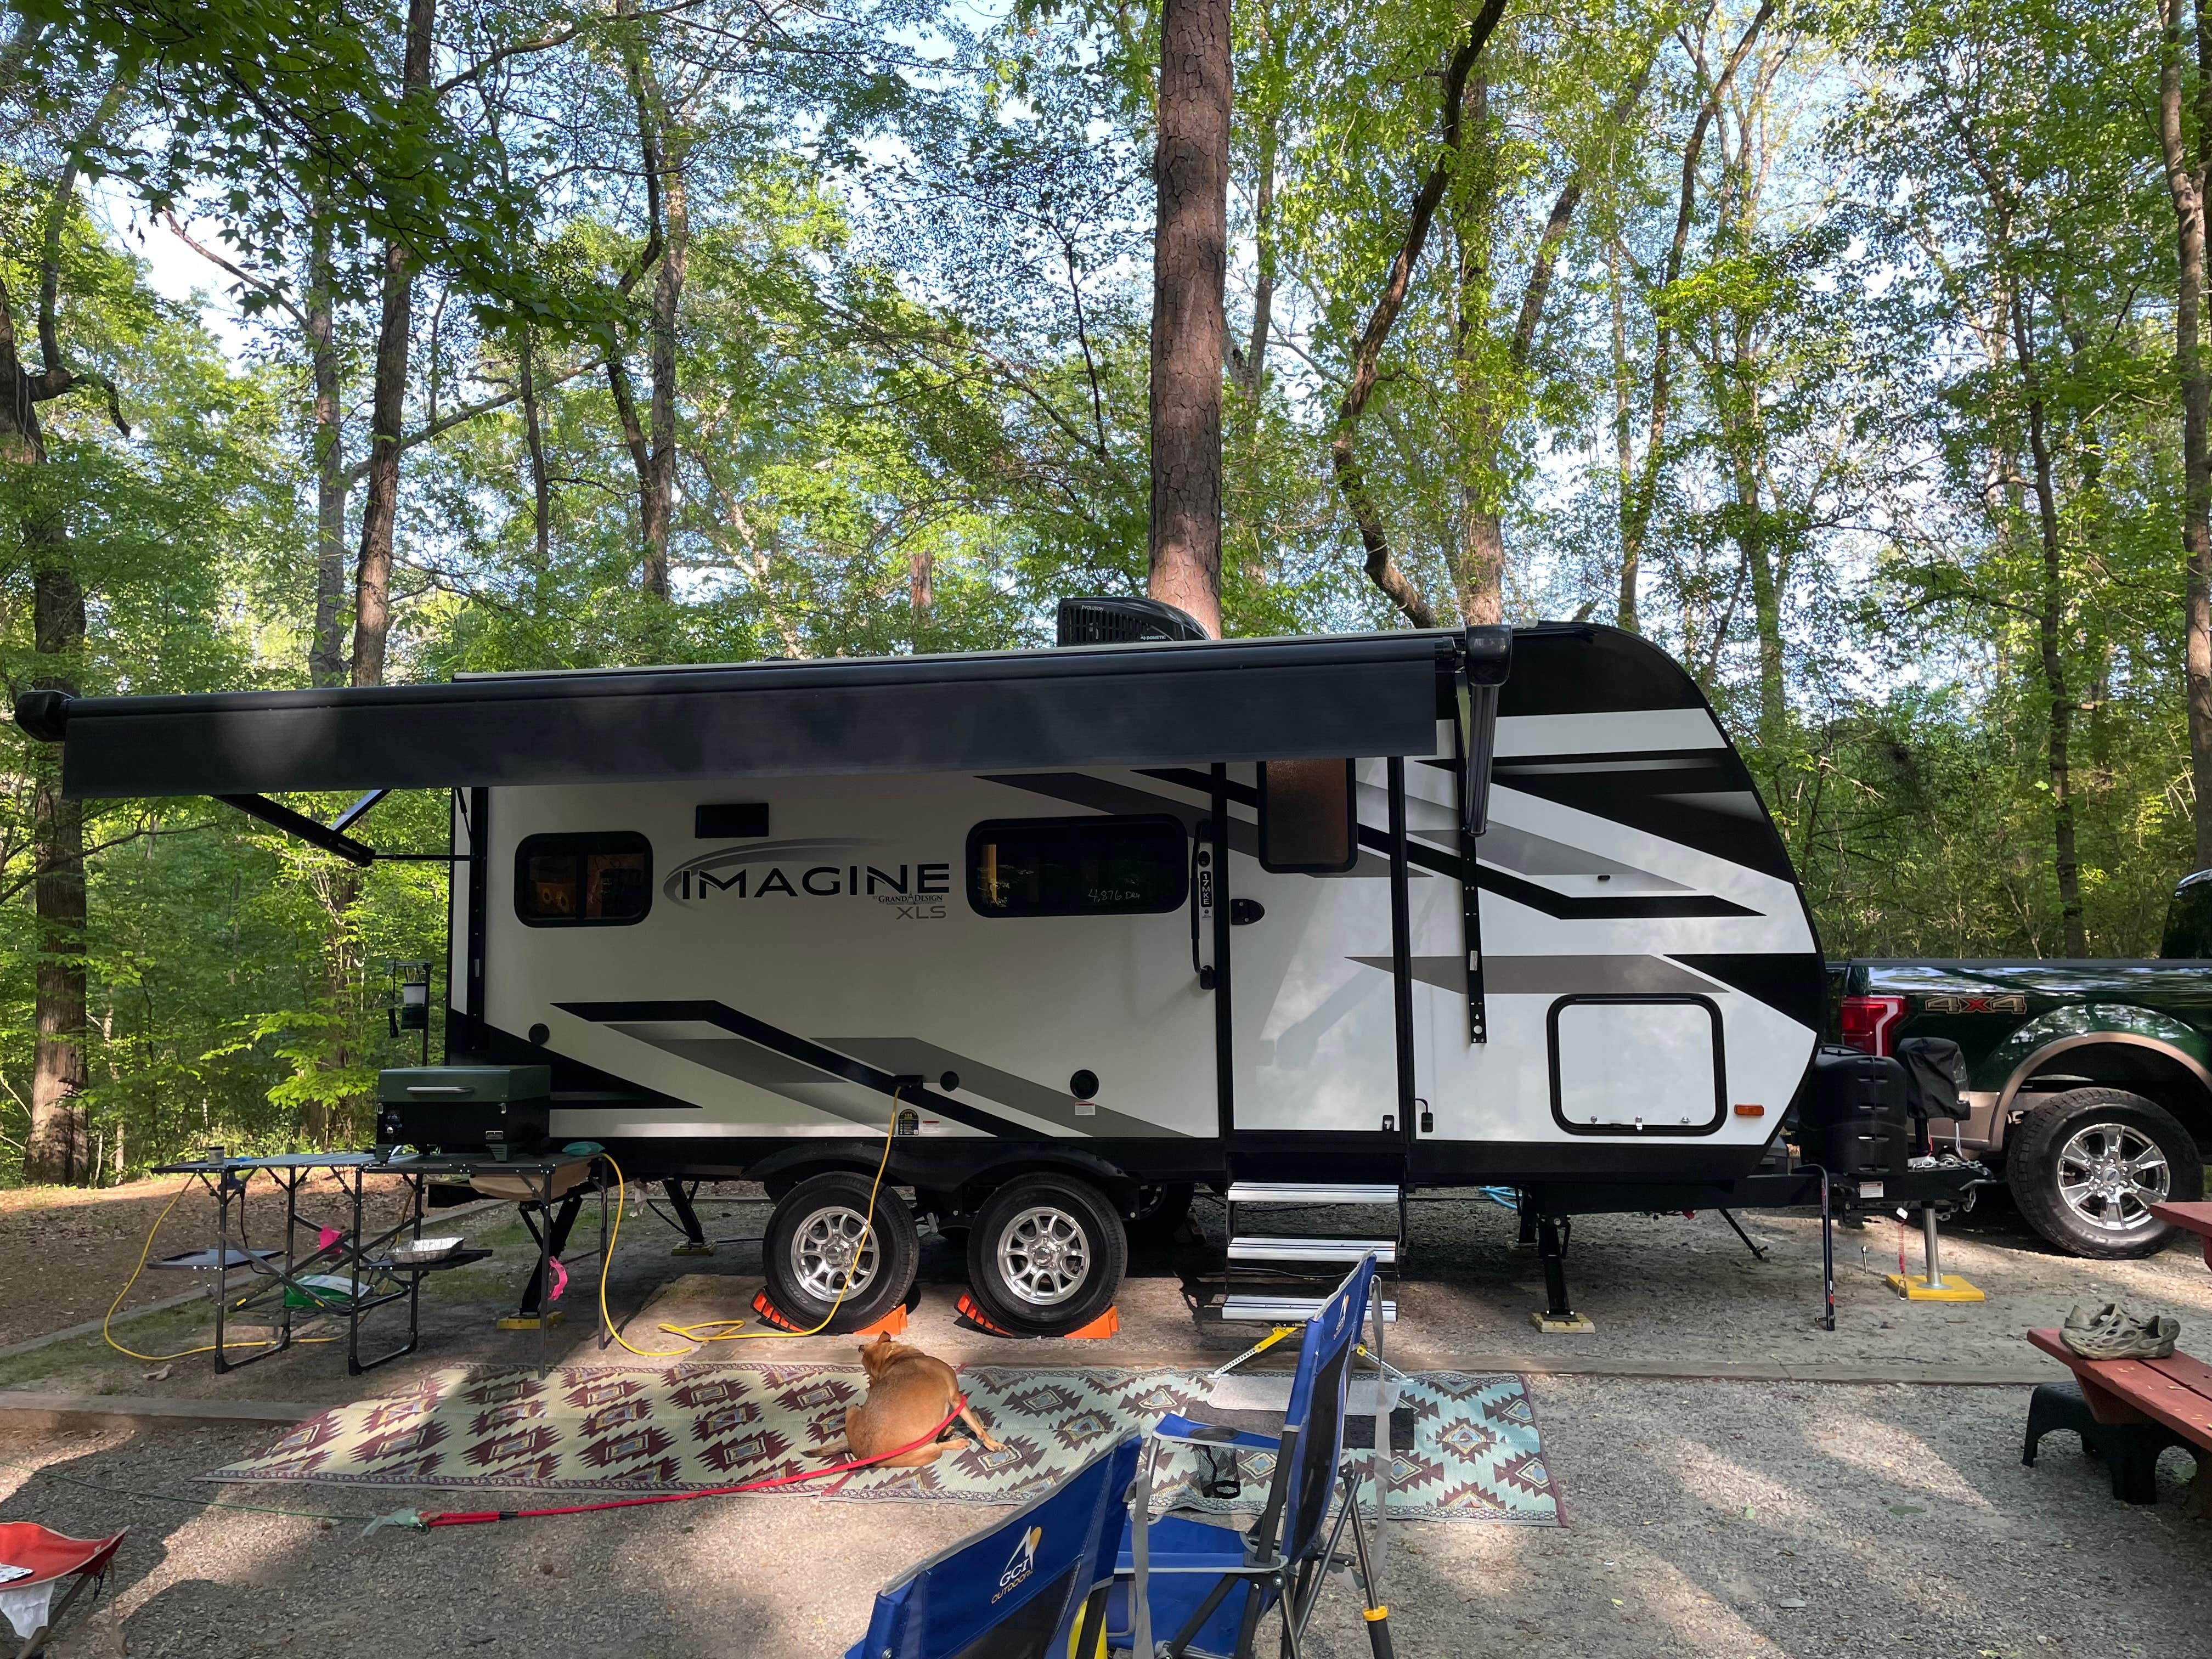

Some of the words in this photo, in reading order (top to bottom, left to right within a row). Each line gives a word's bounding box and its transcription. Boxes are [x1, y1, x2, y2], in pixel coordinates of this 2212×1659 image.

[682, 863, 950, 900] IMAGINE
[1088, 888, 1122, 902] 4,876
[1201, 873, 1210, 905] 17MKE
[878, 895, 907, 903] GRAND
[896, 905, 947, 920] XLS
[991, 1569, 1031, 1604] OUTDOOR
[1000, 1558, 1030, 1587] GCI
